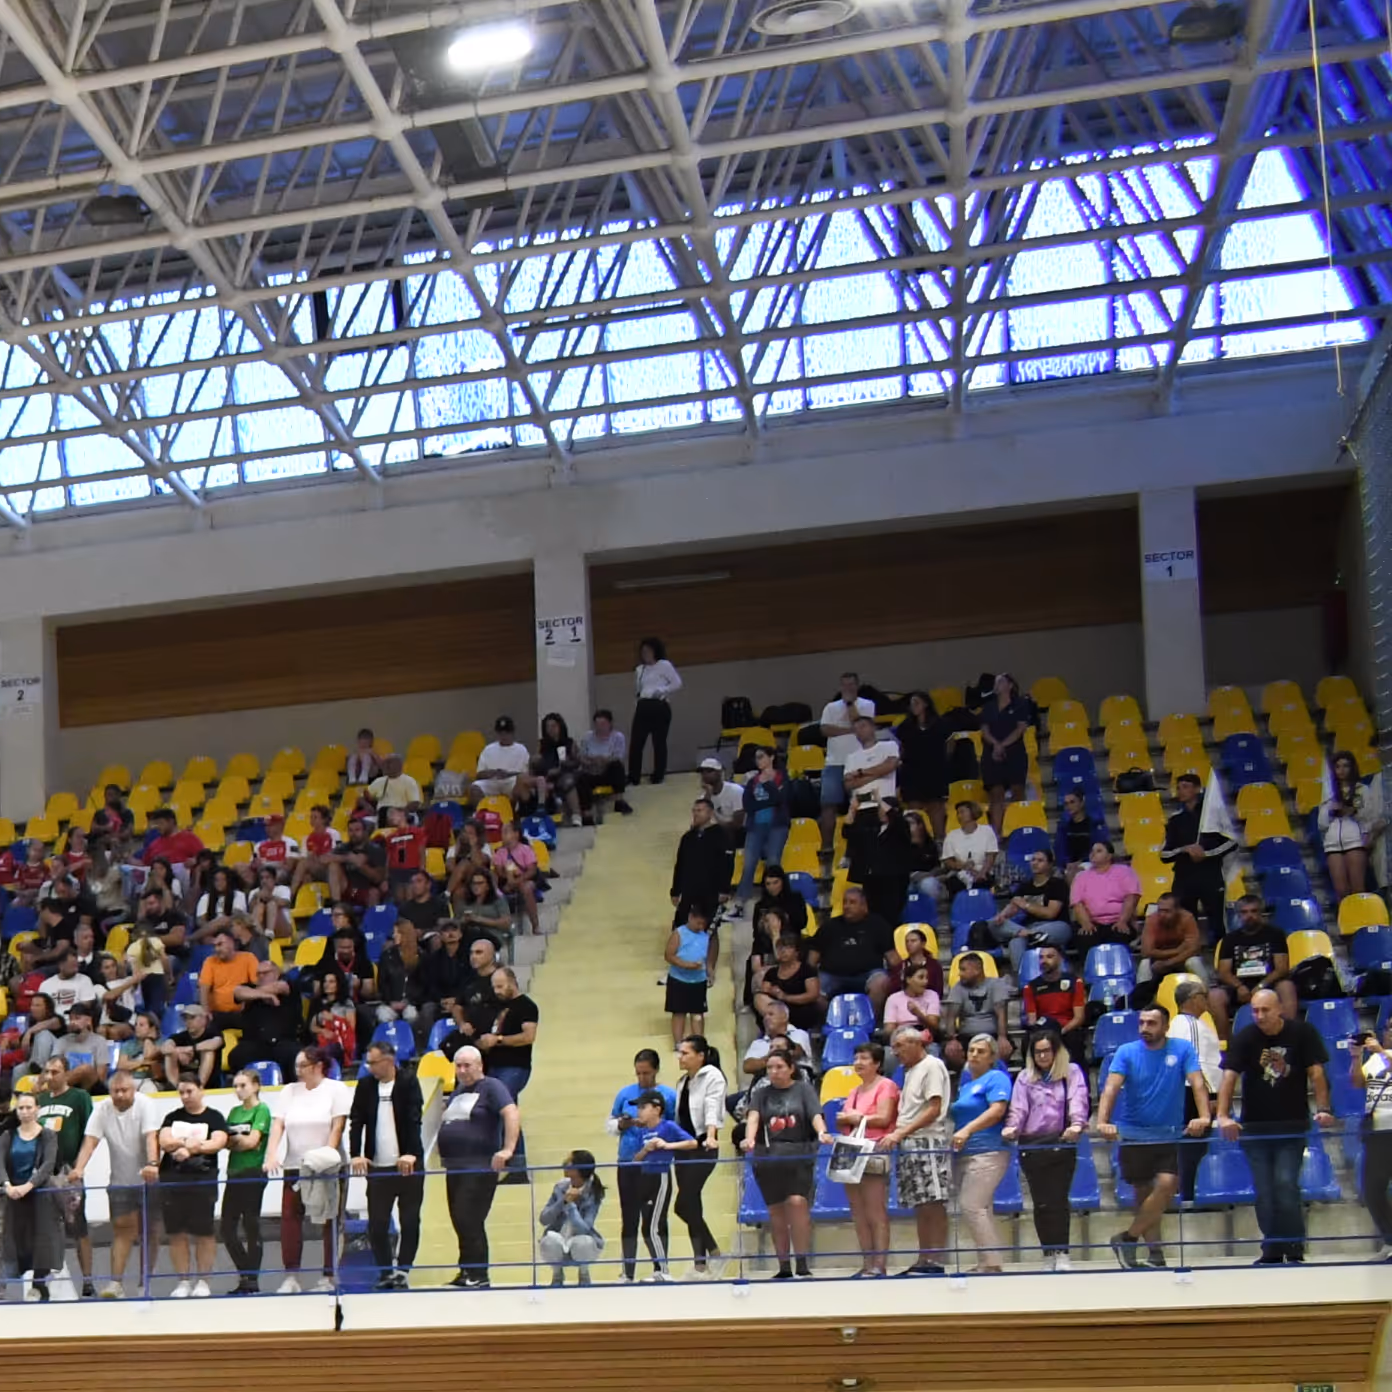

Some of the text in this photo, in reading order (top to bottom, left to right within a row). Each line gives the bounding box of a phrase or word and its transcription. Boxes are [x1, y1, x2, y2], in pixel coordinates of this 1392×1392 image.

[1144, 550, 1194, 563] SECTOR
[1166, 565, 1173, 577] 1
[545, 629, 553, 640] 2
